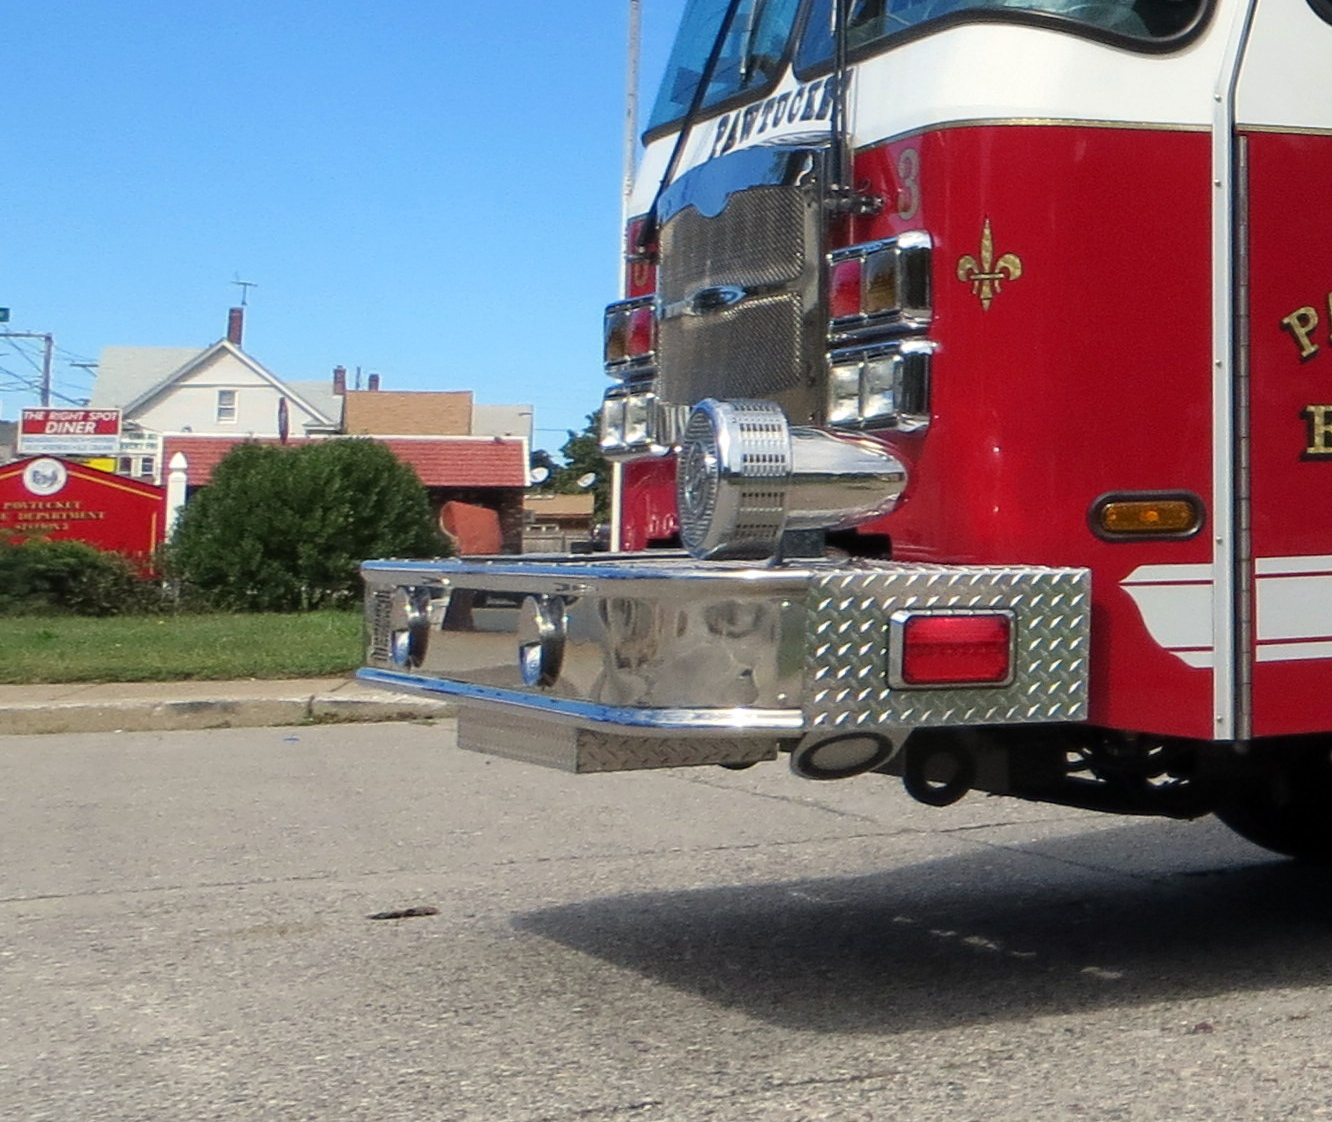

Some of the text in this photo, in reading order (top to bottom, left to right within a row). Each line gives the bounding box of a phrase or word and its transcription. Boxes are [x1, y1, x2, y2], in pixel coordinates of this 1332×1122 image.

[898, 148, 920, 220] 3
[23, 411, 118, 420] THE RIGHT SPOT
[45, 422, 97, 434] DINER
[3, 501, 81, 510] PAWTUCKET
[18, 511, 105, 520] DEPARTMENT
